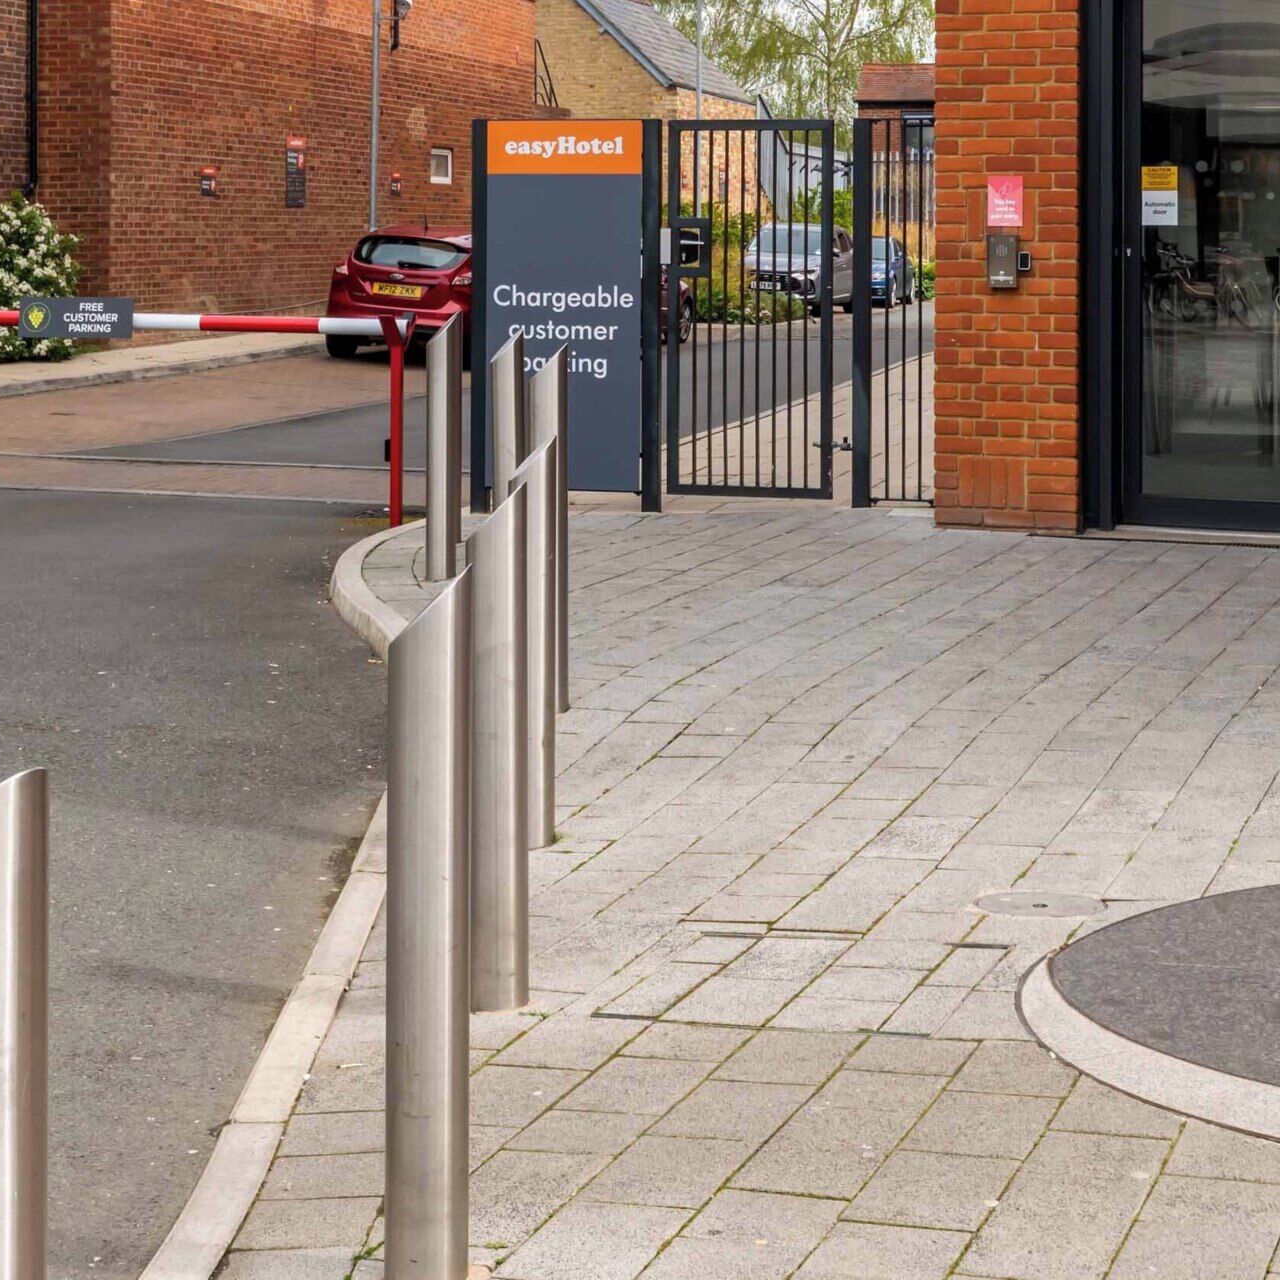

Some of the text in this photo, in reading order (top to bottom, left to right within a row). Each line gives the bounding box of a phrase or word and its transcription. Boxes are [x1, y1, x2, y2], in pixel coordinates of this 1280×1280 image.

[505, 136, 624, 158] easyHotel
[493, 284, 634, 313] Chargeable
[79, 302, 104, 312] FREE
[63, 312, 118, 322] CUSTOMER
[68, 323, 112, 333] PARKING
[508, 320, 619, 341] customer
